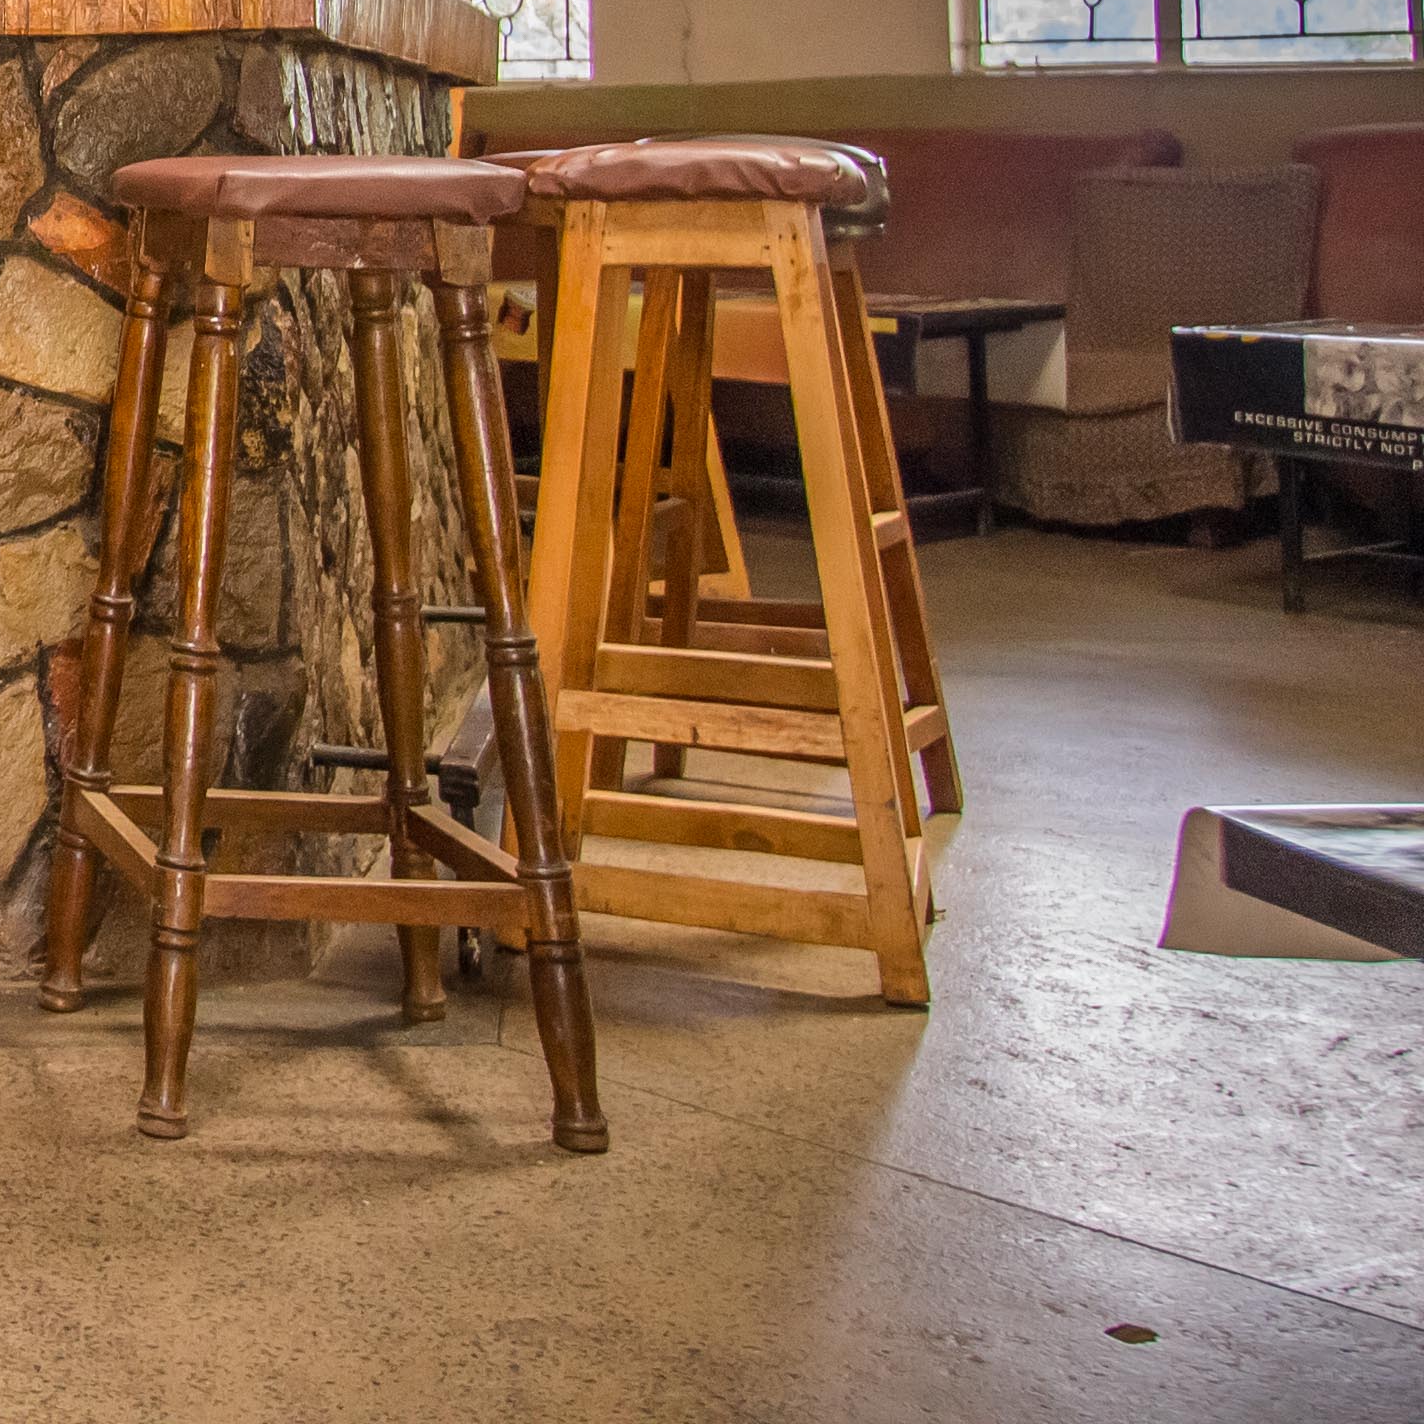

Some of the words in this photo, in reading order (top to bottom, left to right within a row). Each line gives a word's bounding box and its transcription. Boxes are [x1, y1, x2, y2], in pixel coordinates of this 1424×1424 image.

[1234, 410, 1324, 433] EXCESSIVE
[1330, 422, 1424, 444] CONSUMP
[1293, 431, 1373, 452] STRICTLY
[1380, 441, 1416, 456] NOT
